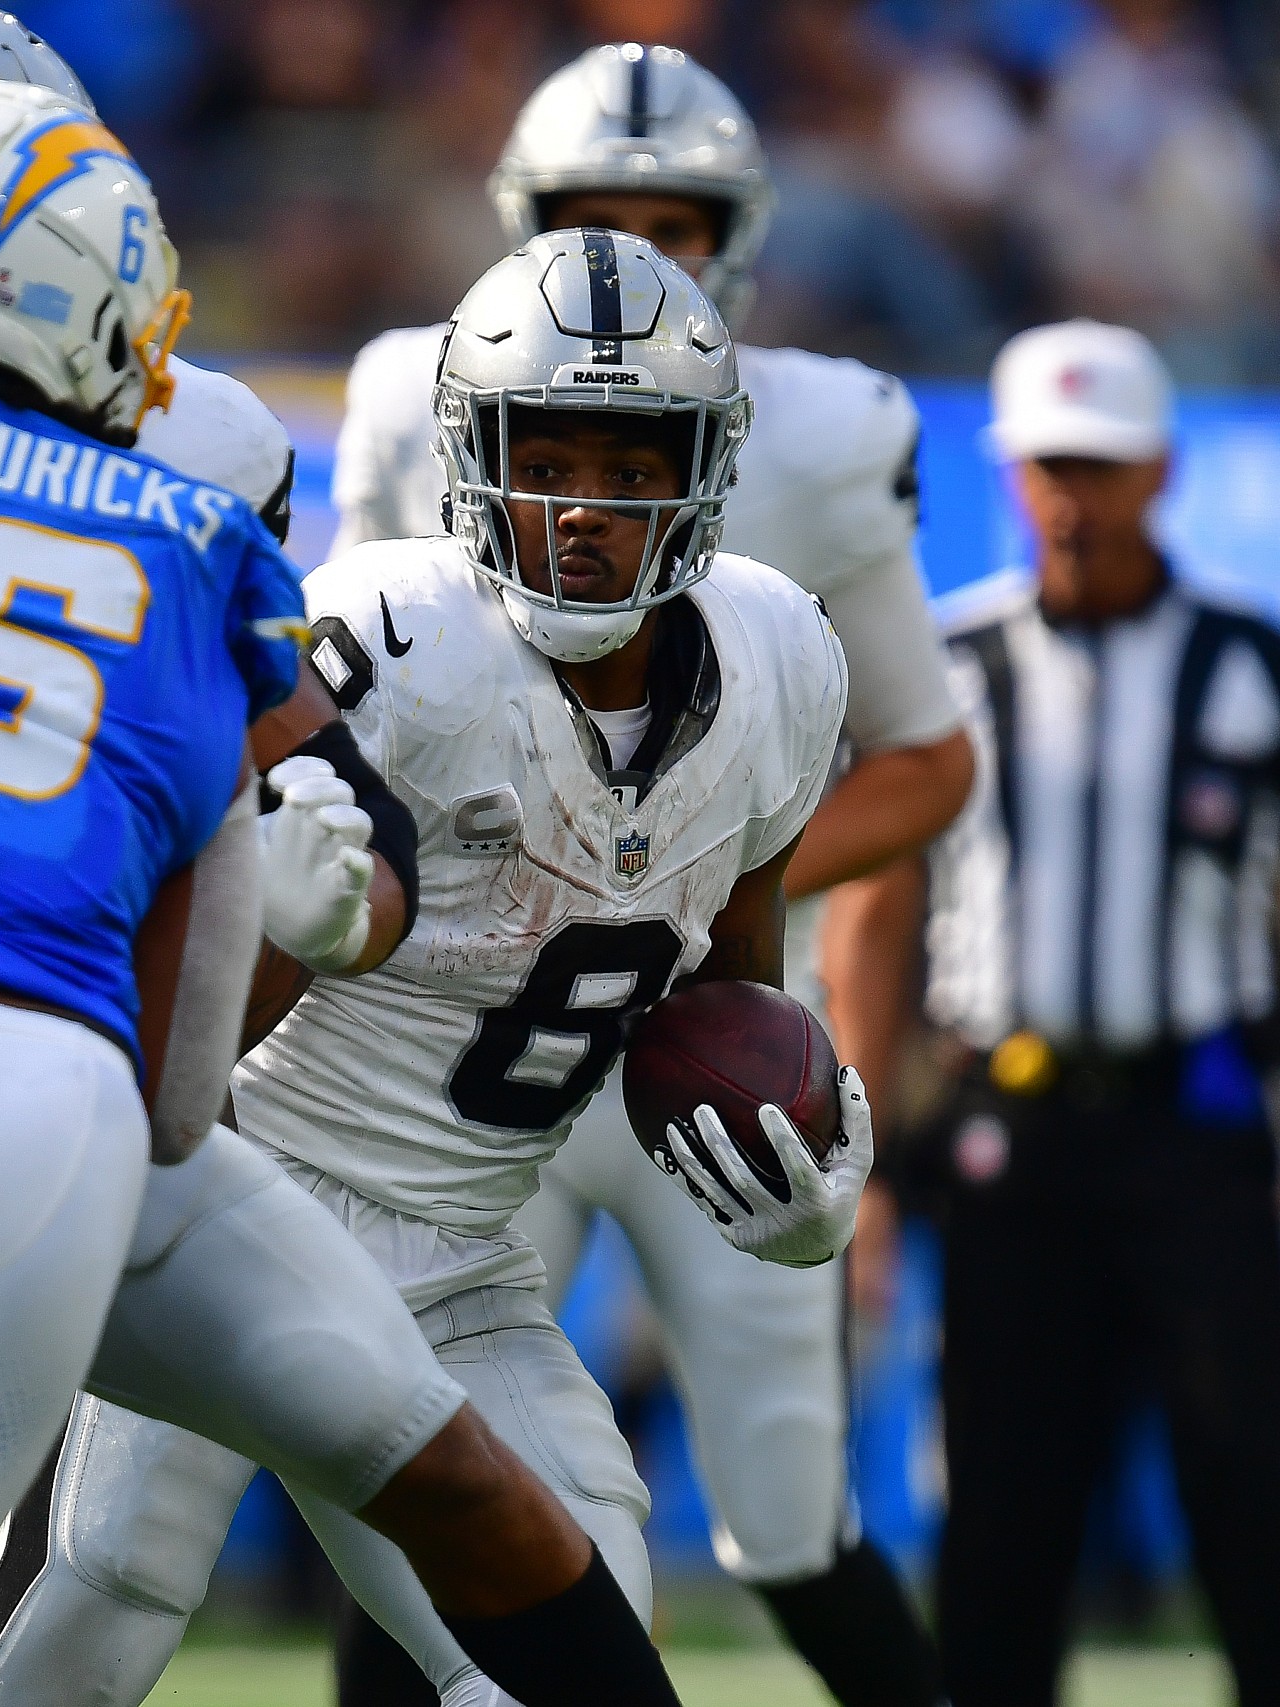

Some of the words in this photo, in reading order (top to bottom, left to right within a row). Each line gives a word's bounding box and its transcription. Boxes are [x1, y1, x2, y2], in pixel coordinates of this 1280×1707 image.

[120, 204, 148, 284] 6
[573, 371, 640, 386] RAIDERS
[454, 792, 518, 841] C
[622, 853, 644, 870] NFL
[448, 916, 687, 1133] 8
